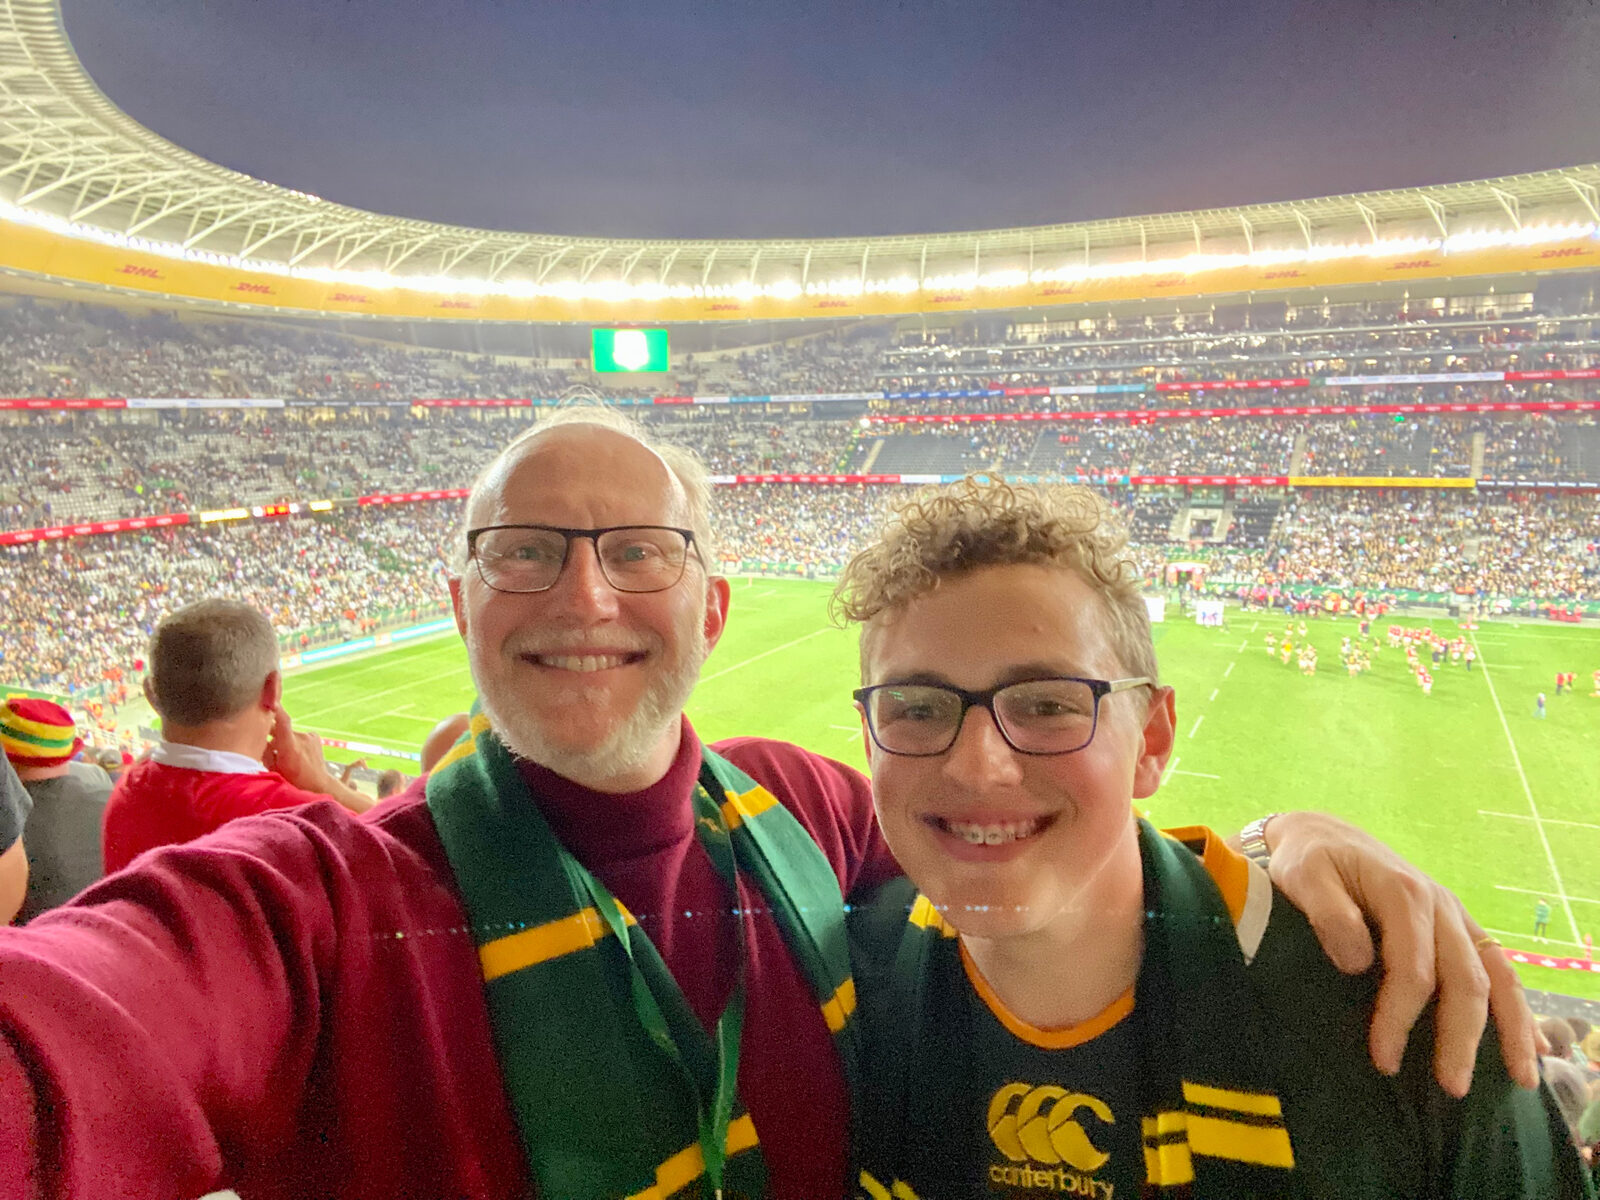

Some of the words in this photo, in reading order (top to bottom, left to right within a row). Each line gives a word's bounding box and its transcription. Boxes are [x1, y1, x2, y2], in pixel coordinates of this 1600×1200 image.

[1539, 247, 1584, 259] DHL
[121, 263, 160, 279] DHL
[236, 282, 272, 295] DHL
[988, 1162, 1115, 1200] canterbury
